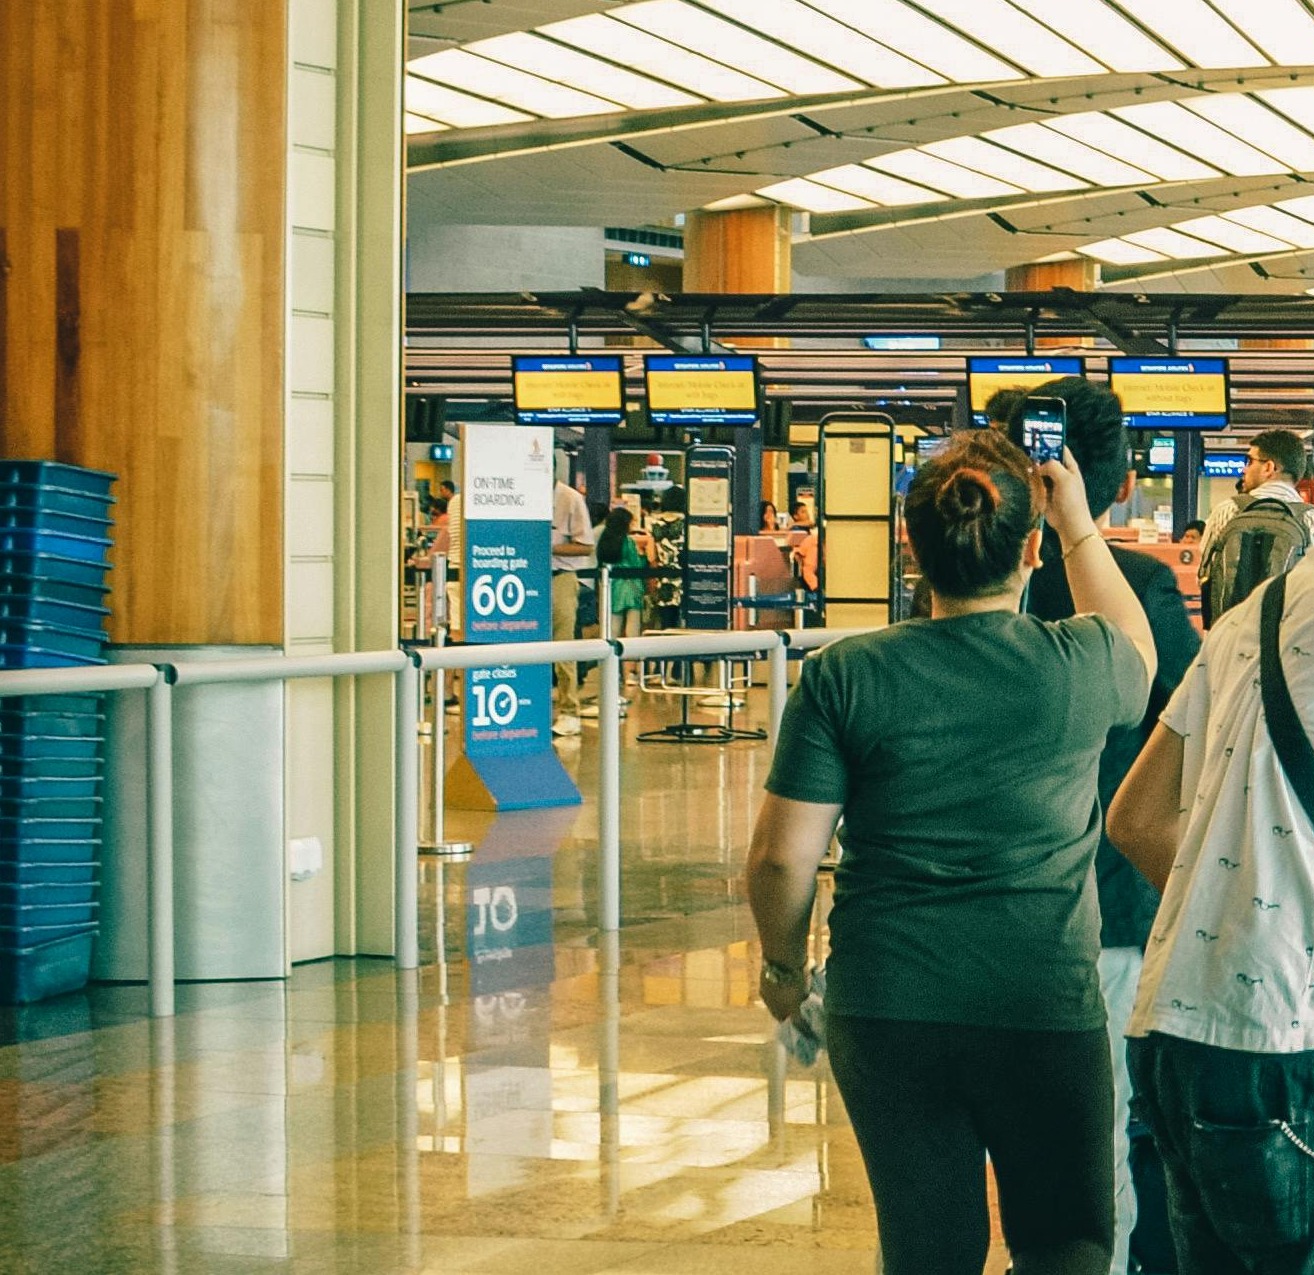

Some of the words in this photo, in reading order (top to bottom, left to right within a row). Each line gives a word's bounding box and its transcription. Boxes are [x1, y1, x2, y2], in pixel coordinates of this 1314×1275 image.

[473, 477, 515, 490] ON-TIME
[473, 493, 525, 506] BOARDING
[472, 545, 505, 556] Proceed
[506, 545, 515, 556] to
[1183, 552, 1191, 562] 2
[472, 558, 508, 571] boarding
[509, 558, 528, 571] gate
[472, 574, 525, 616] 60
[472, 684, 518, 726] 10
